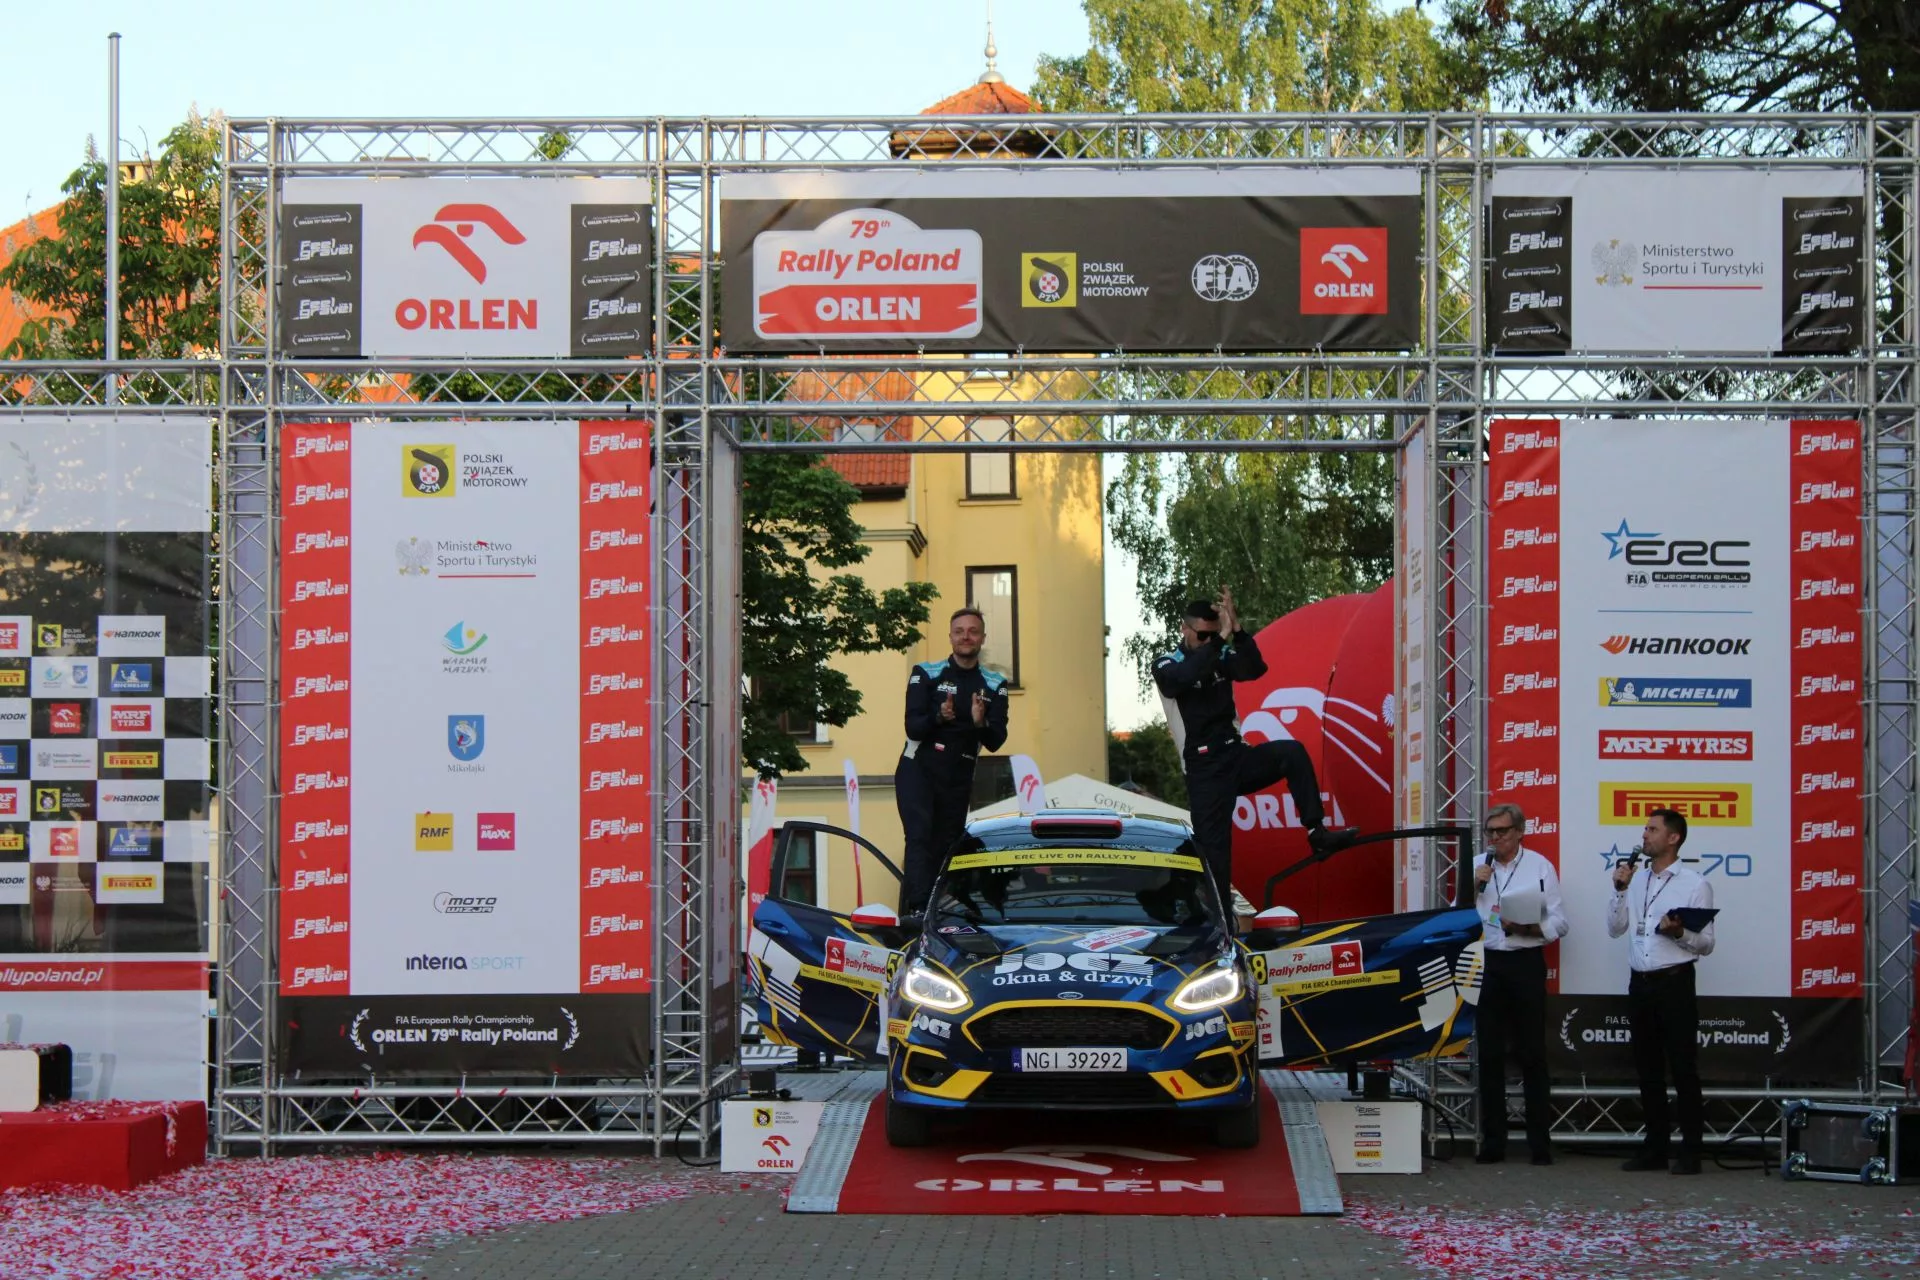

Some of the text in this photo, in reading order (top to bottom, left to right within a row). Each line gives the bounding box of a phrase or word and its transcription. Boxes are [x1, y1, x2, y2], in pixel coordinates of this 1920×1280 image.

[849, 219, 890, 239] 79th
[1643, 244, 1734, 257] Ministerstwo
[778, 248, 961, 279] Rally Poland
[1083, 262, 1123, 272] POLSKI
[1642, 261, 1764, 277] Sportu i Turystyki
[1083, 274, 1135, 286] ZWIĄZEK
[1038, 291, 1061, 302] PZM
[1083, 286, 1149, 297] MOTOROWY
[1314, 283, 1374, 297] ORLEN
[395, 298, 538, 331] ORLEN
[815, 297, 921, 321] ORLEN
[463, 454, 503, 463] POLSKI
[418, 483, 441, 493] PZM
[463, 478, 528, 487] MOTOROWY
[437, 541, 512, 551] Ministerstwo
[1625, 540, 1751, 566] ERC
[437, 554, 537, 568] Sportu i Turystyki
[1641, 687, 1740, 700] MICHELIN
[112, 710, 150, 719] MRF
[1603, 737, 1748, 754] MRF TYRES
[109, 754, 153, 764] PIRELLI
[1613, 790, 1739, 818] PIRELLI
[420, 828, 450, 838] RMF
[1086, 853, 1137, 861] RALLY.TV
[448, 897, 497, 906] MOTO
[406, 954, 524, 971] interia SPORT
[995, 952, 1154, 975] JOCZ
[1269, 961, 1332, 977] Rally Poland
[992, 970, 1154, 987] okna & drzwi
[1302, 976, 1371, 990] FIA ERC4 Championship
[395, 1015, 535, 1026] FIA European Rally Championship
[1605, 1015, 1619, 1025] FIA
[371, 1028, 558, 1045] ORLEN 79th Rally Poland
[1714, 1031, 1769, 1045] Poland
[1026, 1052, 1058, 1069] NGI
[1067, 1052, 1122, 1069] 39292
[757, 1159, 794, 1168] ORLEN
[915, 1178, 1224, 1193] ORLEN
